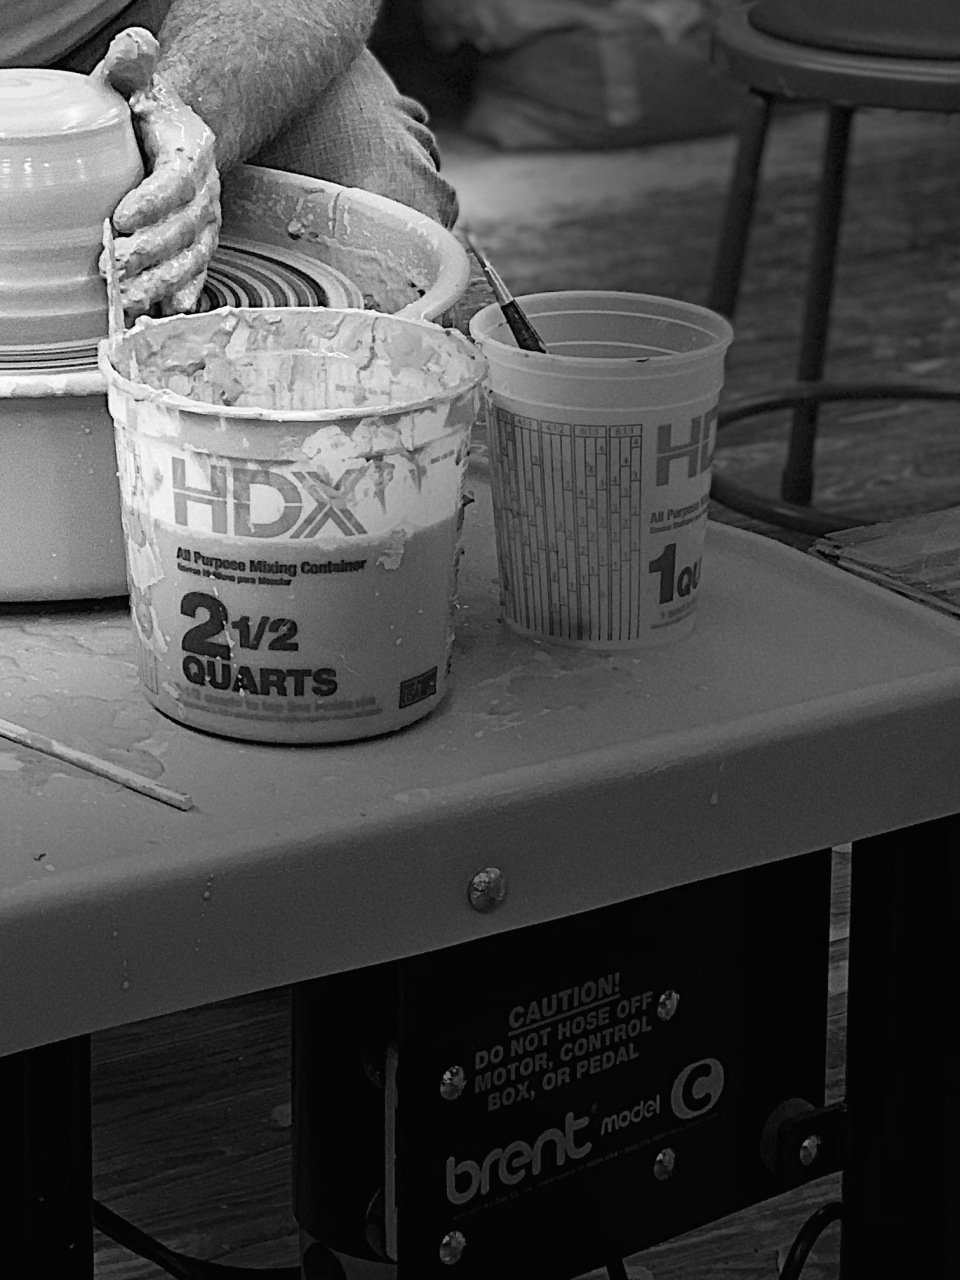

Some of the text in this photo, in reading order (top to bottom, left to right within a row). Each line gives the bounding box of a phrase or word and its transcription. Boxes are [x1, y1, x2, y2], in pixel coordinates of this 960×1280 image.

[171, 456, 373, 540] HDX
[177, 547, 367, 577] All Purpose Mixing Container
[648, 543, 677, 605] 1
[180, 591, 299, 660] 2 1/2
[182, 655, 338, 697] QUARTS
[475, 991, 654, 1070] DO NOT HOSE OFF
[508, 971, 620, 1029] CAUTION!
[474, 1015, 653, 1094] MOTOR, CONTROL
[487, 1042, 640, 1112] BOX, OR PEDAL
[446, 1111, 593, 1205] brent
[600, 1093, 660, 1136] model
